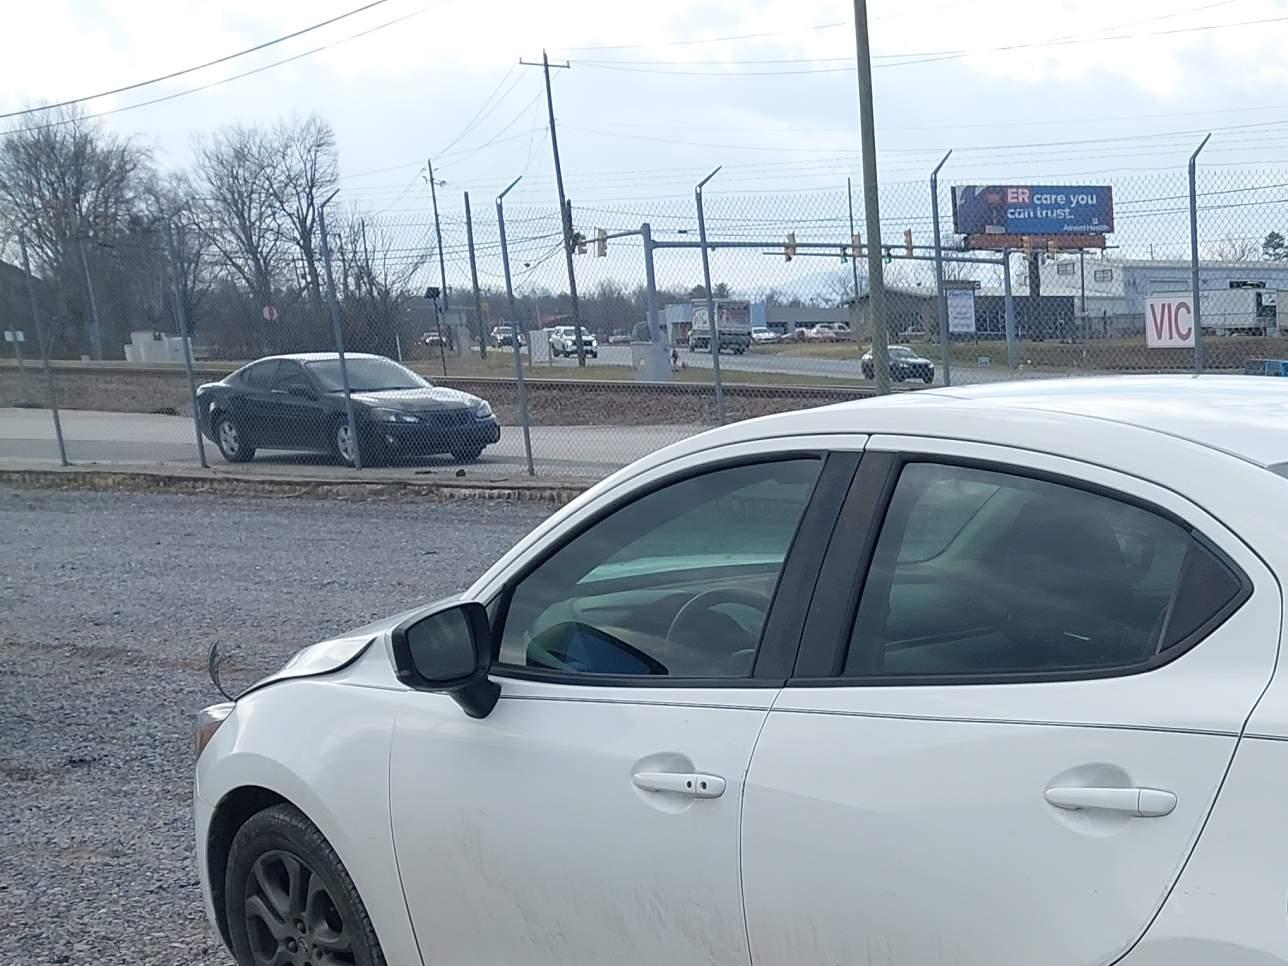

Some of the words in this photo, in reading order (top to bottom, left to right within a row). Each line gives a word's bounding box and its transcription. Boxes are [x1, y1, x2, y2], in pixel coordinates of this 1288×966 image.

[1007, 188, 1030, 203] ER
[1033, 193, 1066, 205] care
[1070, 193, 1097, 207] you
[1007, 208, 1034, 219] can
[1036, 207, 1074, 219] trust.
[1150, 302, 1192, 341] VIC
